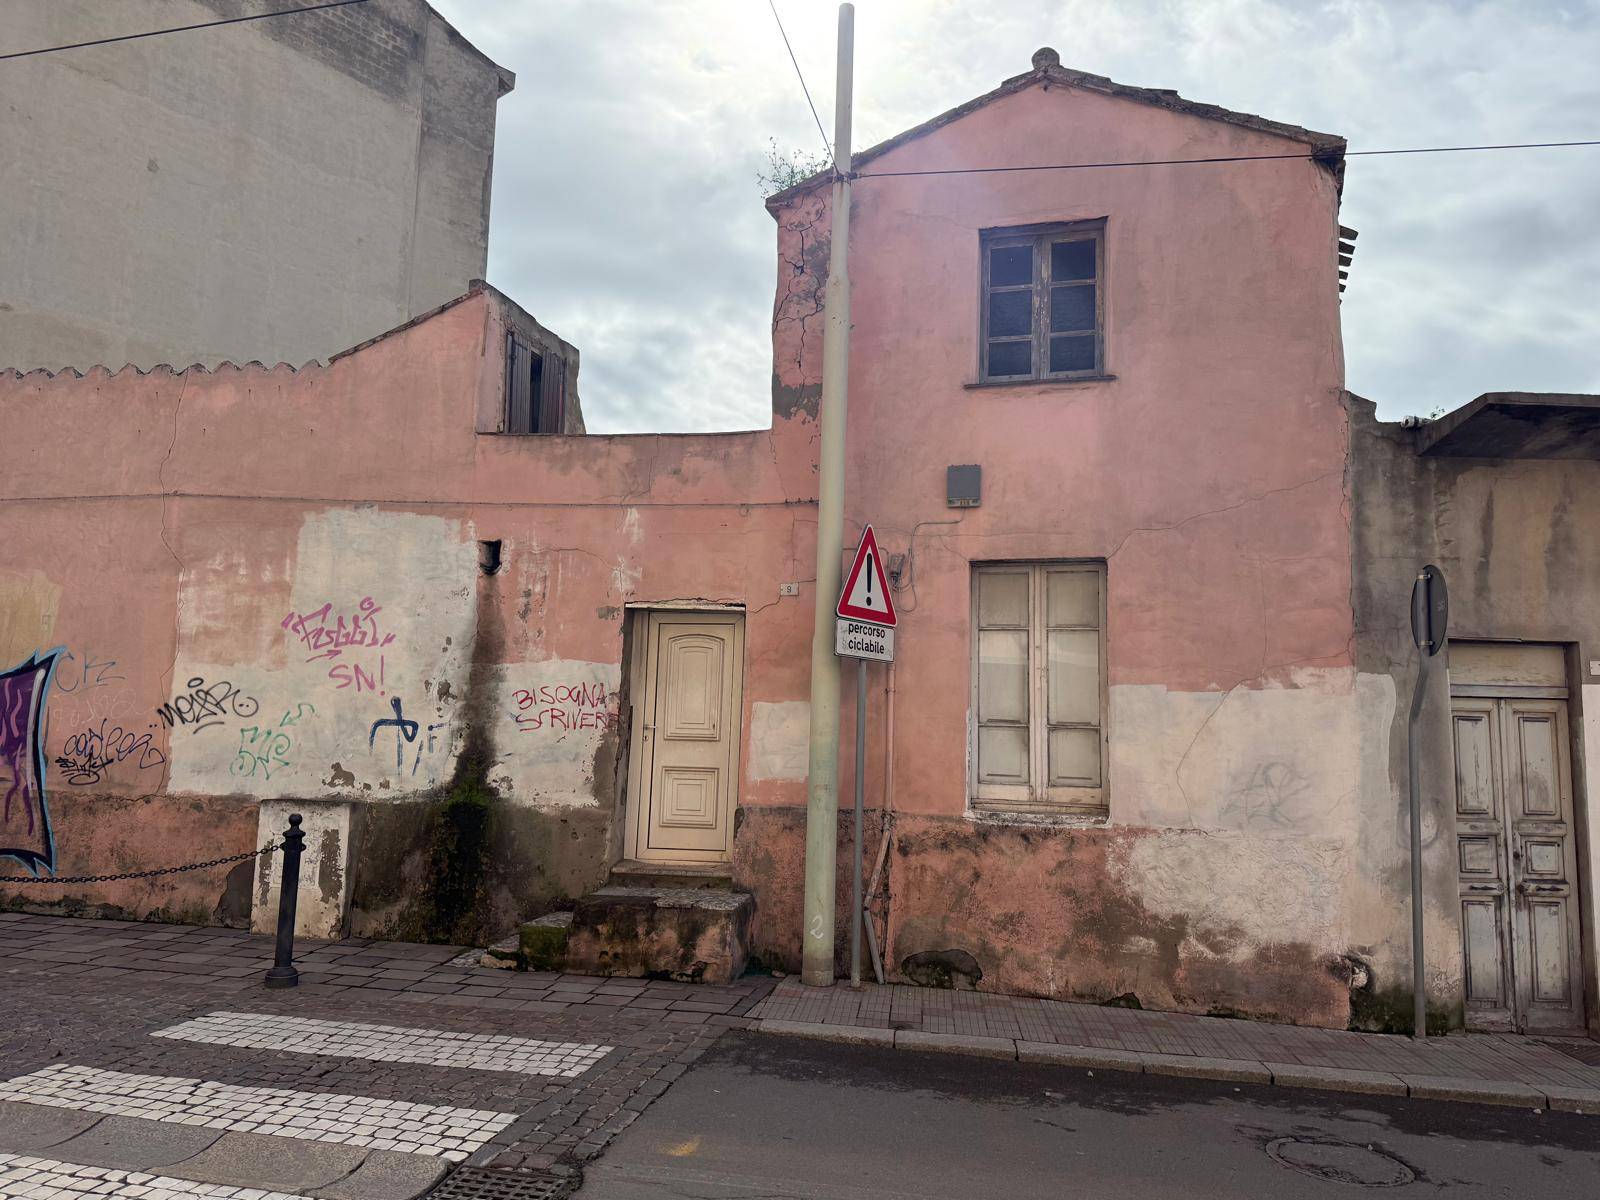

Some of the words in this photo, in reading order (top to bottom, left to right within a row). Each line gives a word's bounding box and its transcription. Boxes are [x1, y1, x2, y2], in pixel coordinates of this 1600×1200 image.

[848, 622, 886, 639] percorso
[848, 637, 885, 654] ciclabile
[512, 682, 607, 710] BISOGNA
